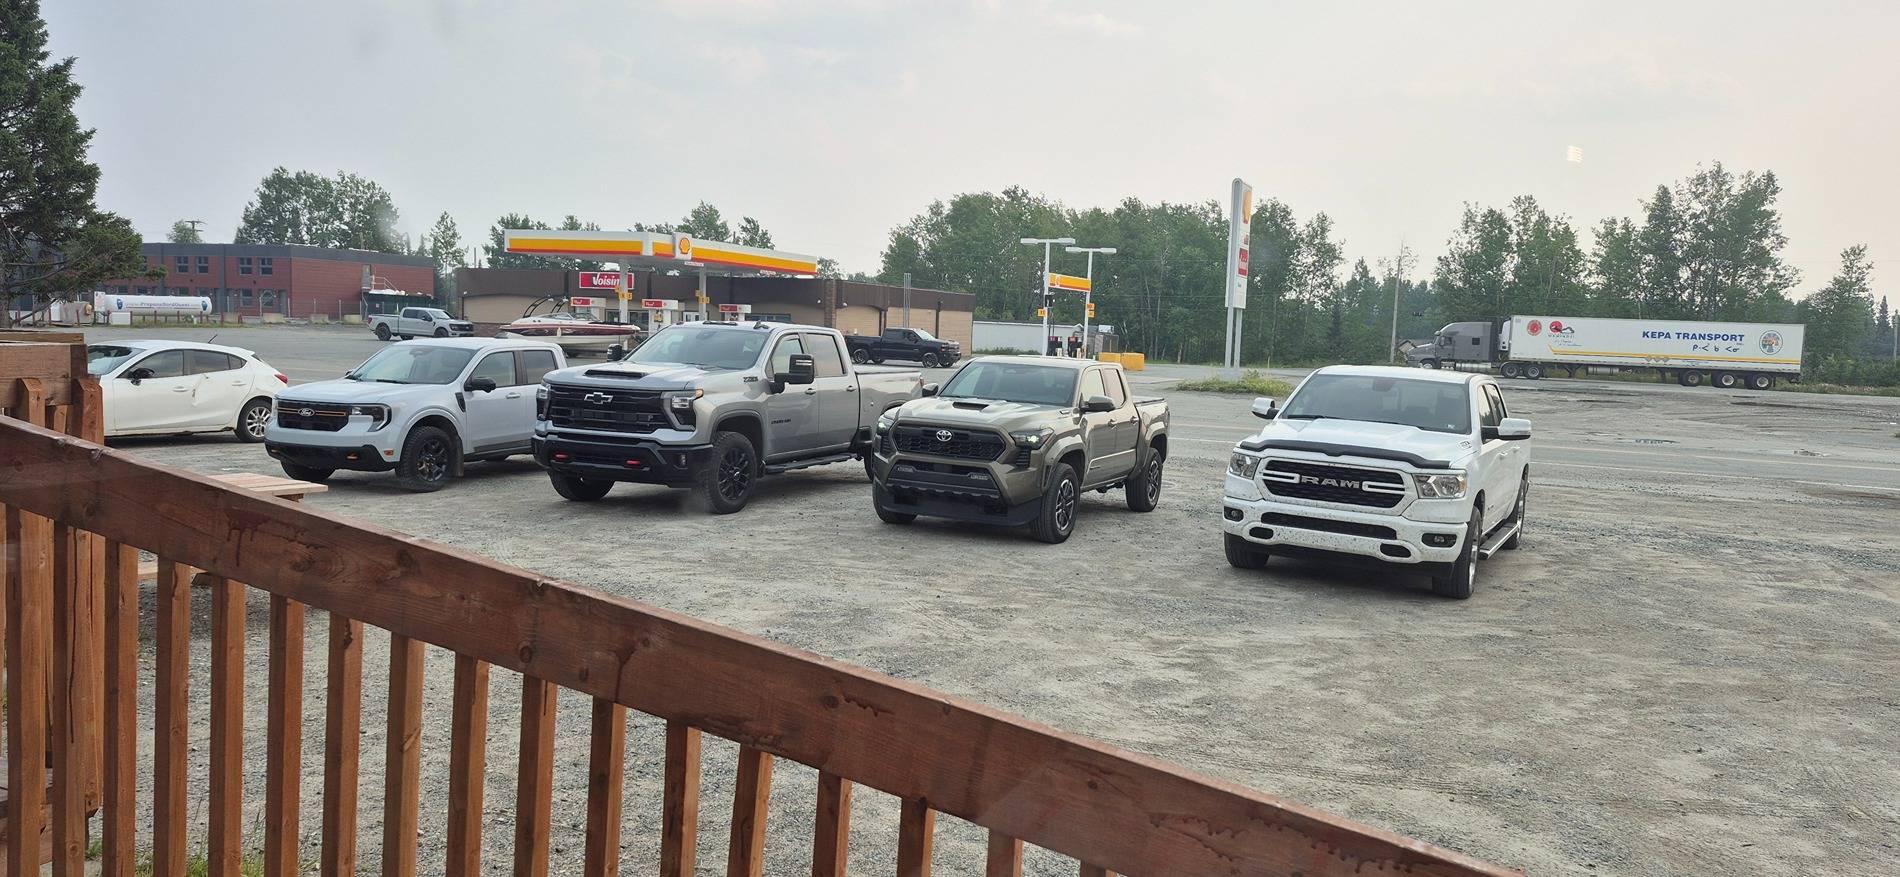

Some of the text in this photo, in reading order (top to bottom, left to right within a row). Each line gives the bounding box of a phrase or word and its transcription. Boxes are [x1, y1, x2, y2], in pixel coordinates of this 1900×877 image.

[1642, 331, 1744, 342] KEPA TRANSPORT
[1301, 475, 1360, 489] RAM
